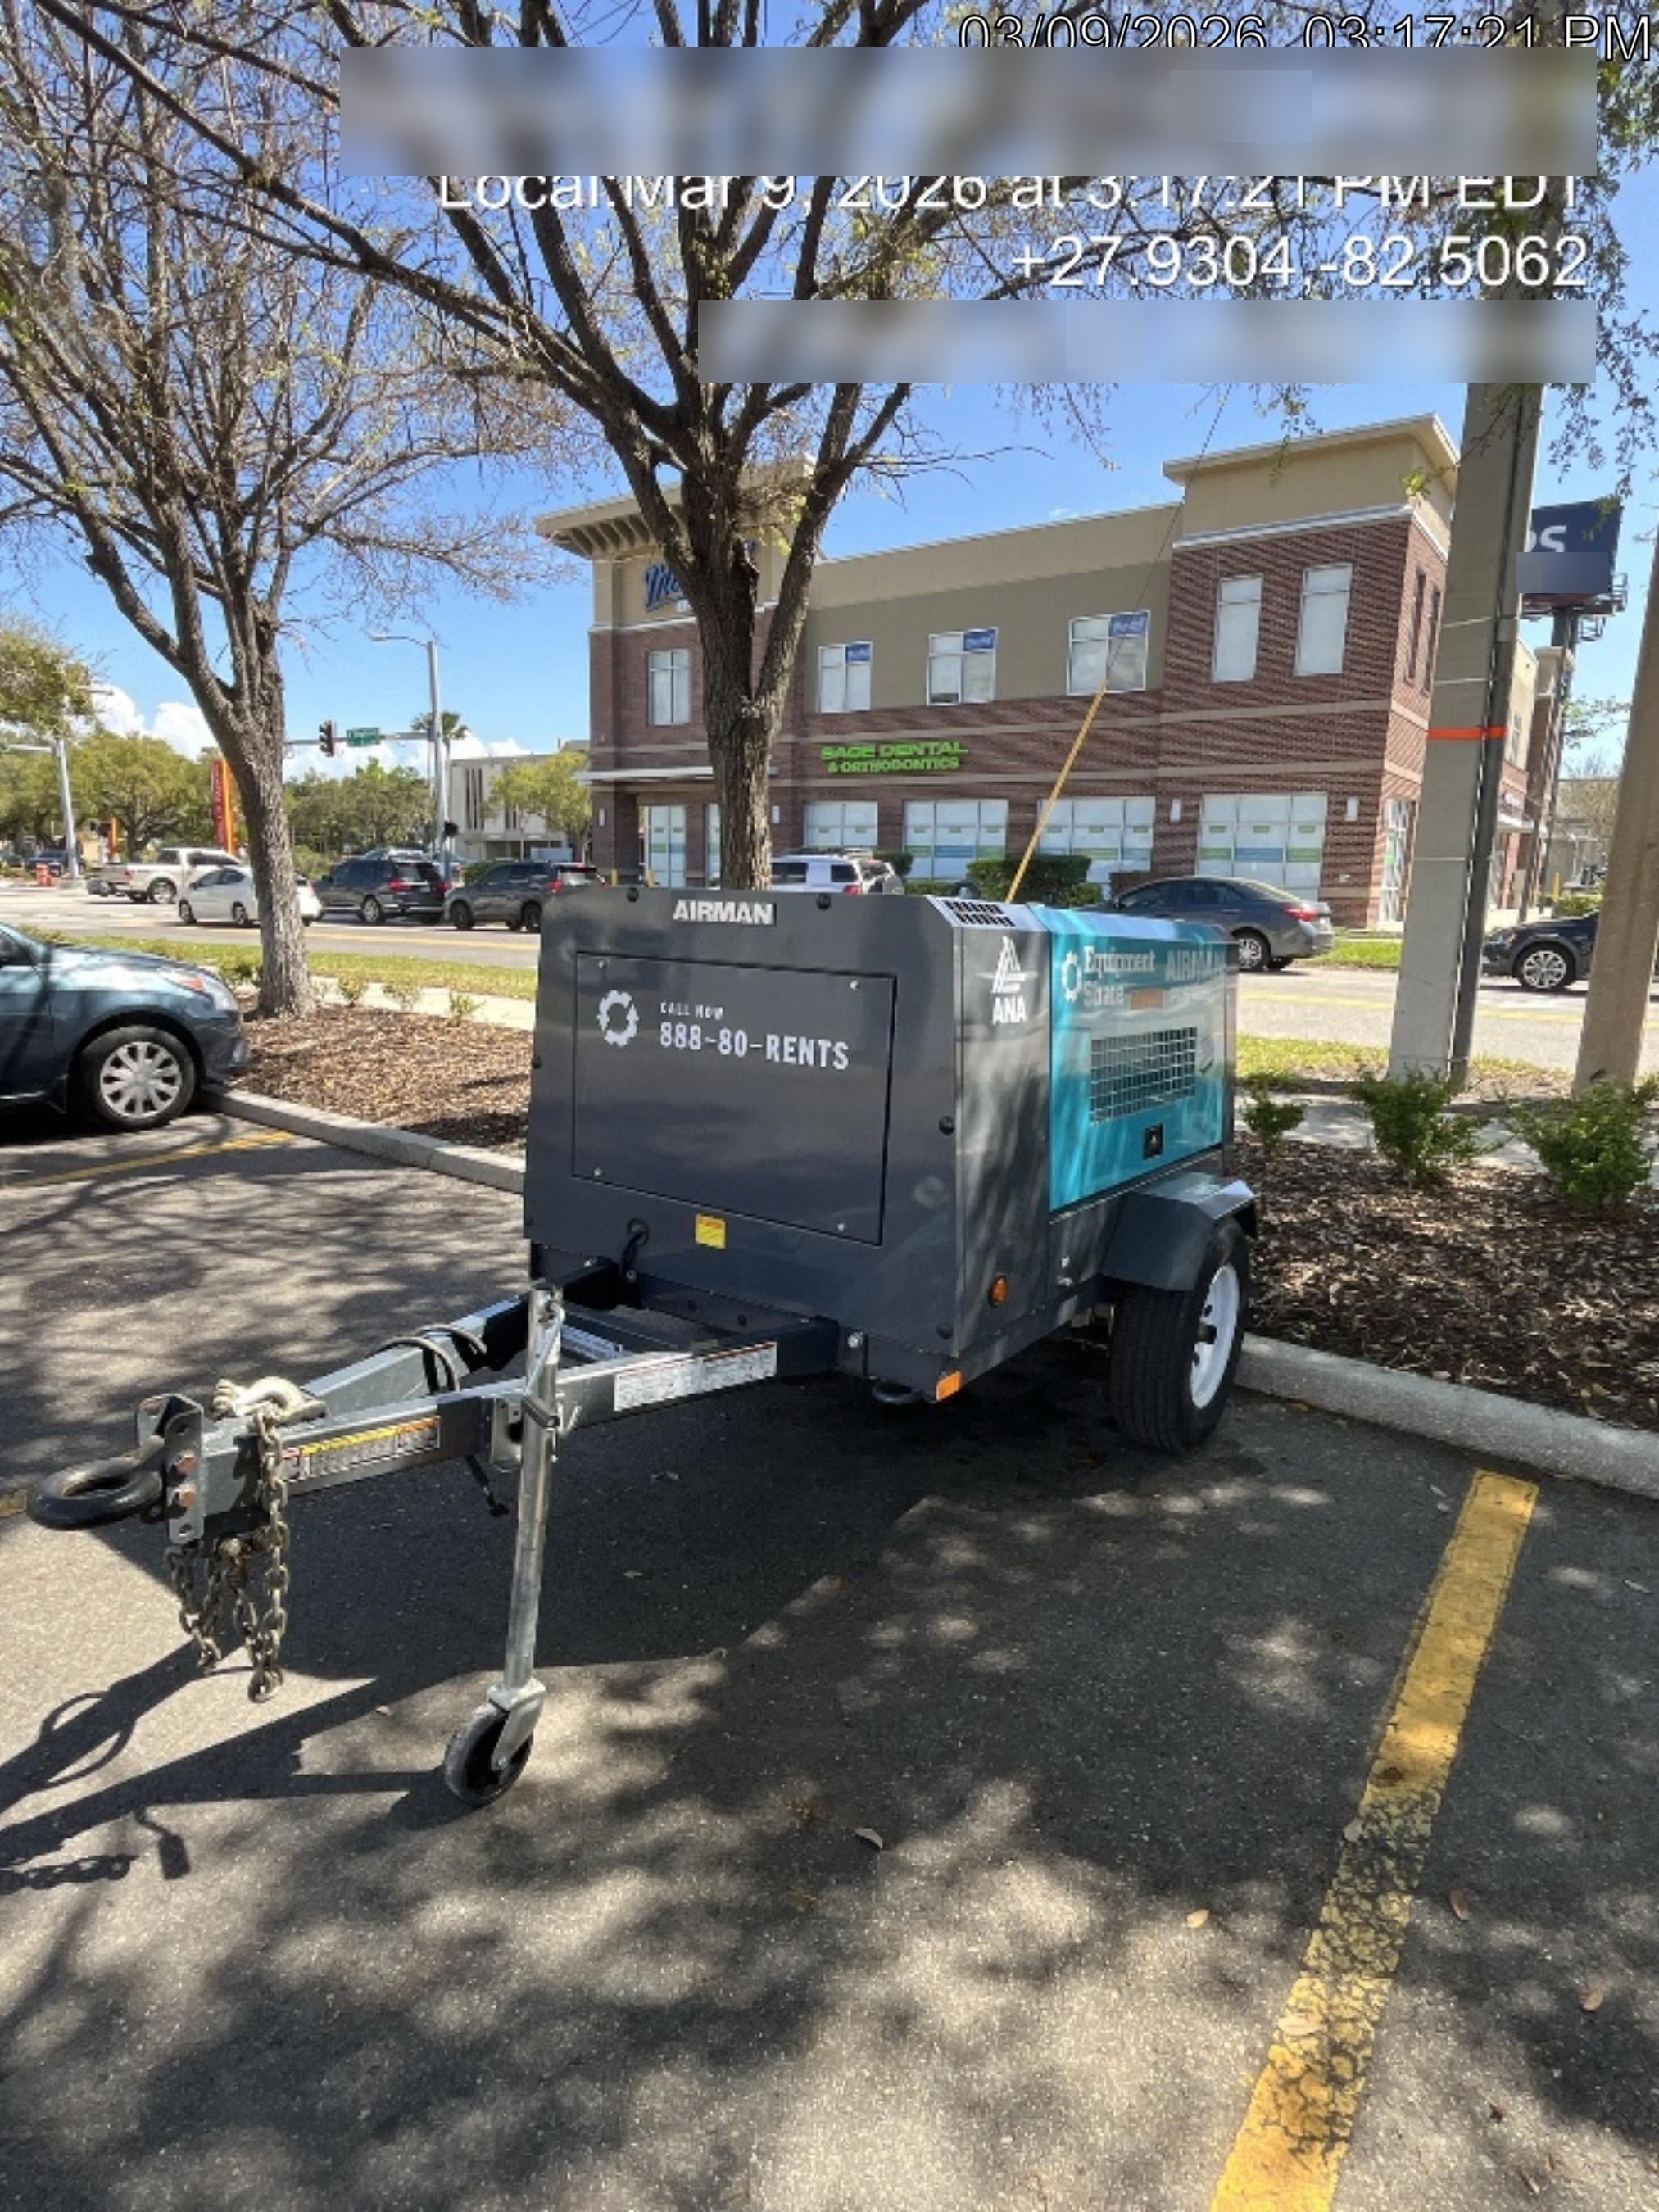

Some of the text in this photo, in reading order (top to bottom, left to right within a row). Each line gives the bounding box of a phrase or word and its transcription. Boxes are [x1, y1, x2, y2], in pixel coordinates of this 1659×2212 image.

[821, 741, 969, 759] SAGE DENTAL
[840, 757, 961, 773] ORTHODONTICS
[672, 899, 774, 926] AIRMAN
[1083, 945, 1156, 978] Equipment
[660, 1002, 723, 1020] CALL NOW
[992, 995, 1027, 1025] ANA
[660, 1022, 850, 1071] 888-80-RENTS
